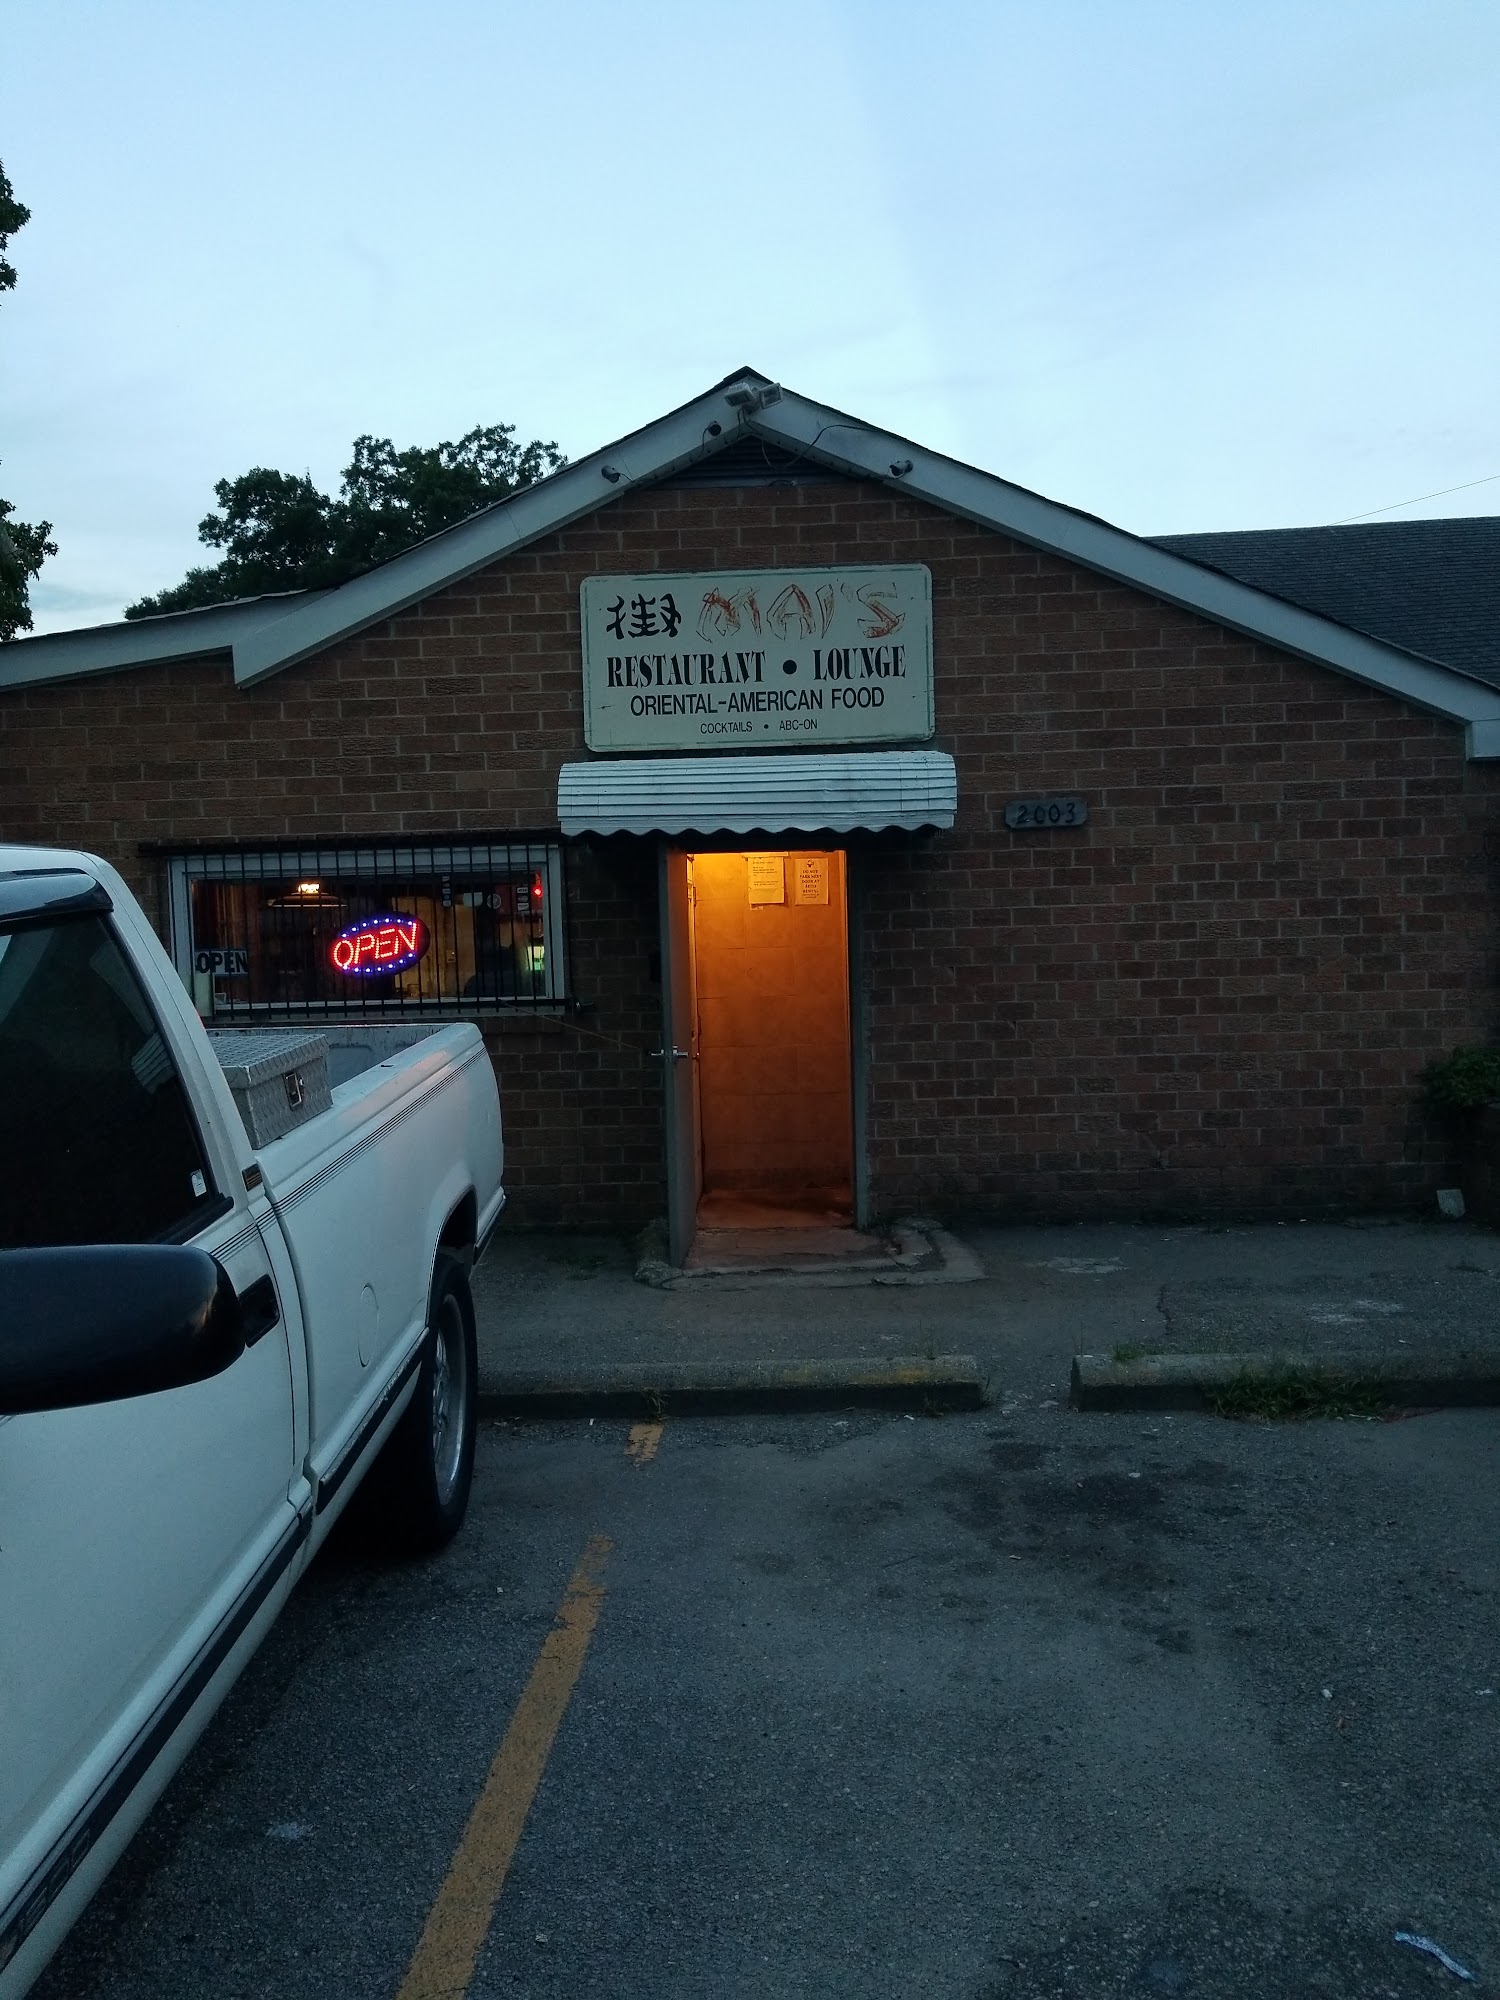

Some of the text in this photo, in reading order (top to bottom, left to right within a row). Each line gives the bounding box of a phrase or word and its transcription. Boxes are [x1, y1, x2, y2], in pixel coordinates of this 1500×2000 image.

[607, 644, 906, 689] RESTAURANT LOUNGE
[630, 686, 885, 716] ORIENTAL-AMERICAN FOOD
[700, 718, 818, 734] COCKTAILS ABC-ON
[1016, 802, 1075, 825] 2003
[333, 922, 417, 968] OPEN
[196, 951, 248, 974] OPEN
